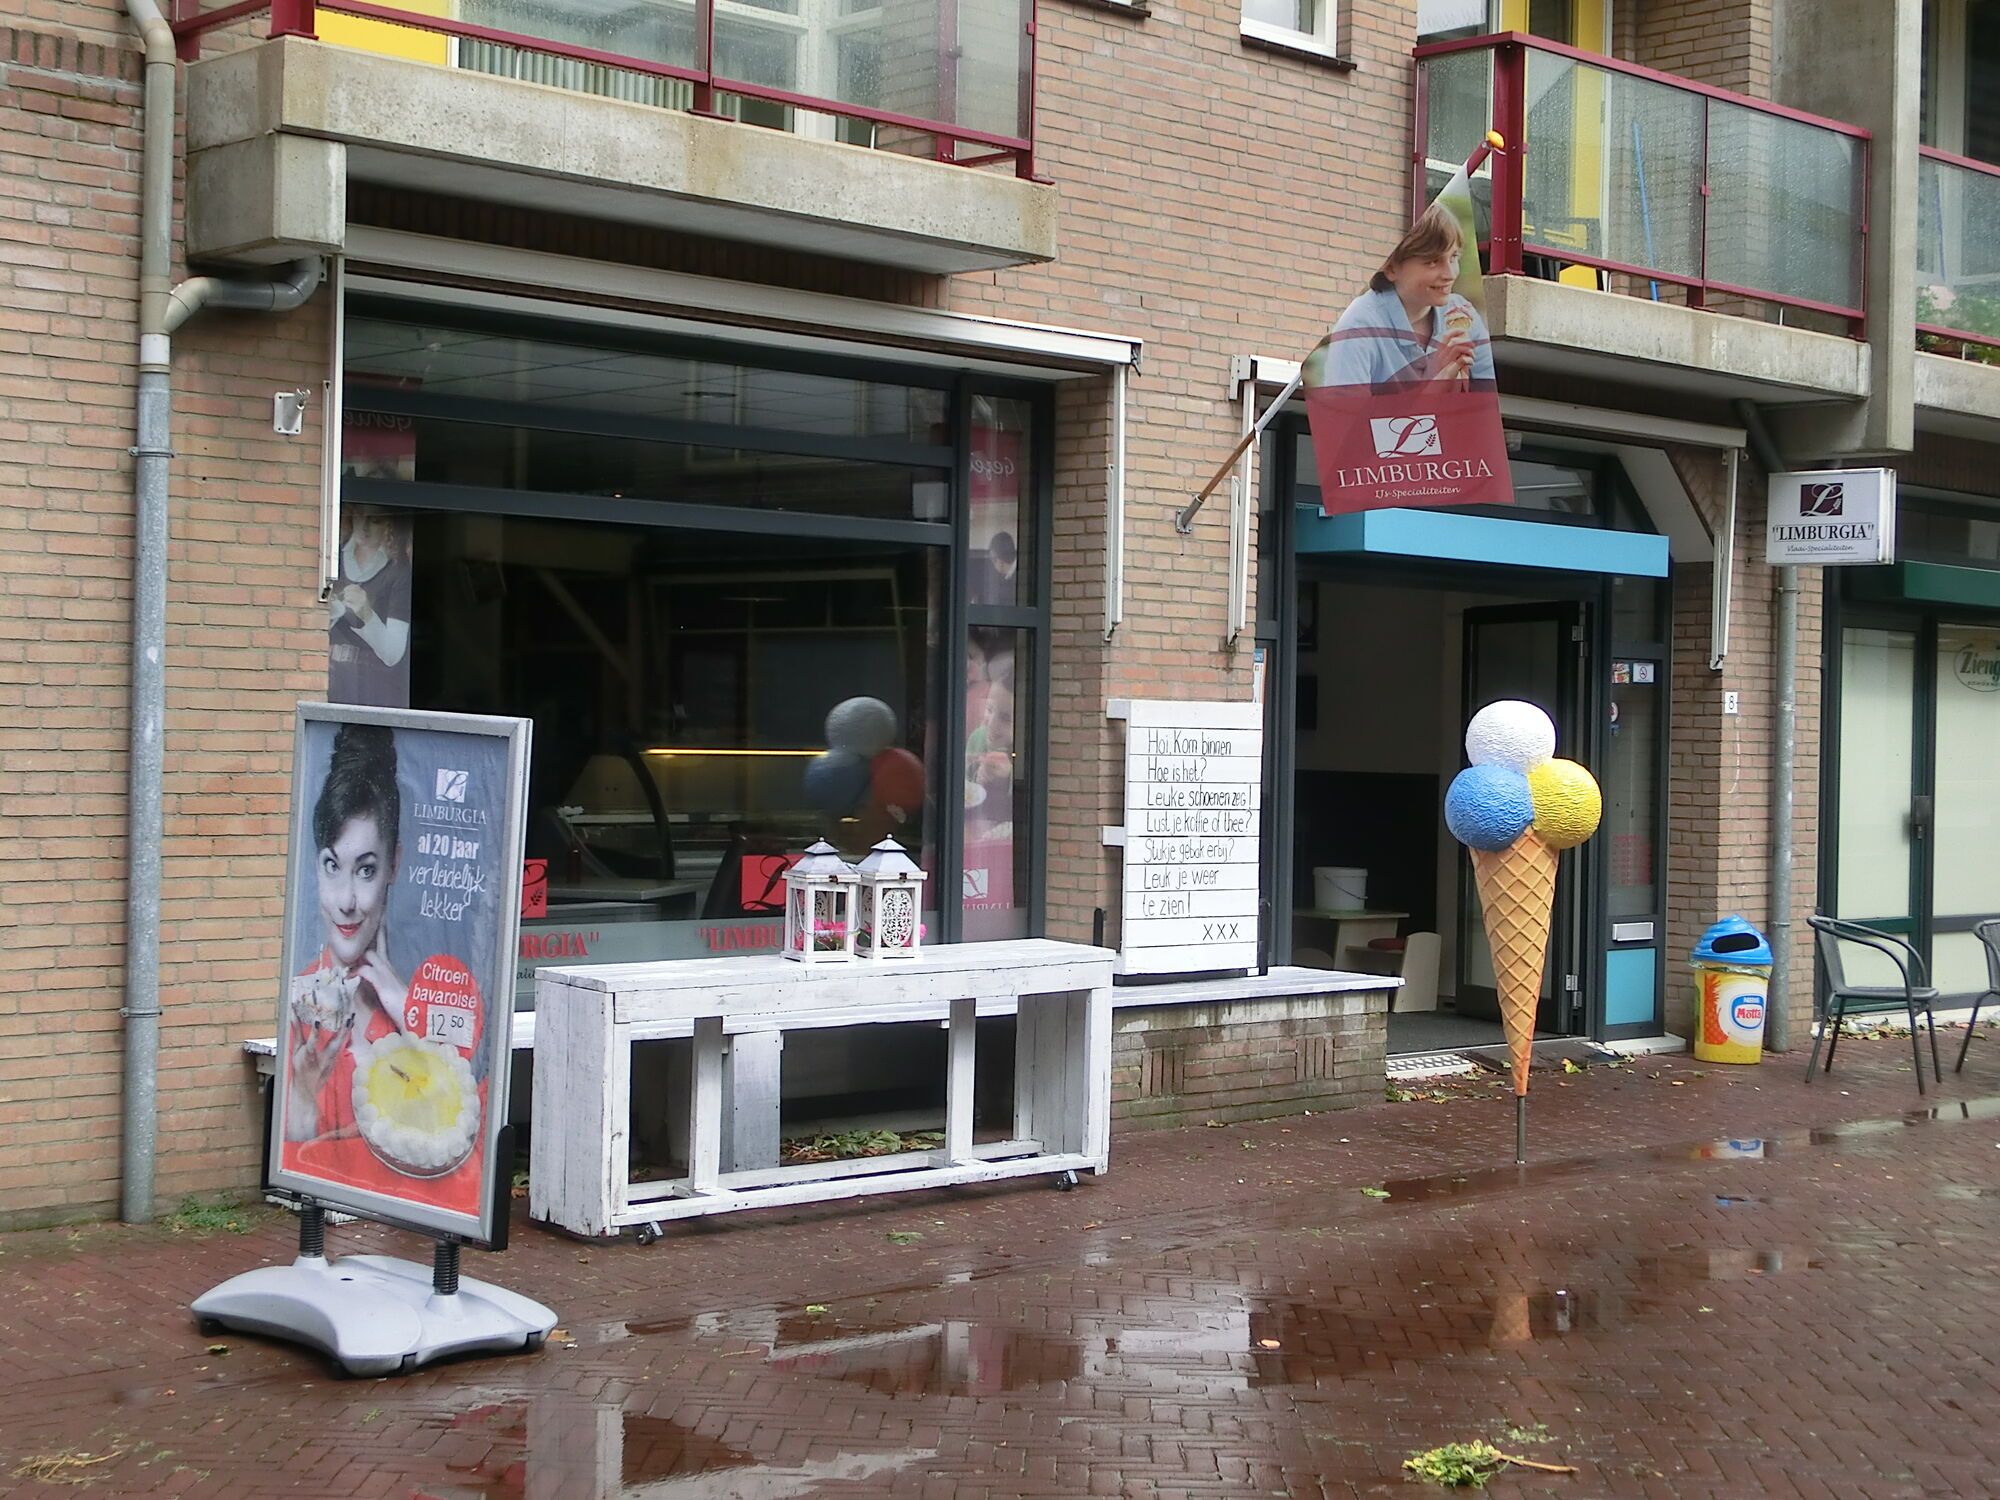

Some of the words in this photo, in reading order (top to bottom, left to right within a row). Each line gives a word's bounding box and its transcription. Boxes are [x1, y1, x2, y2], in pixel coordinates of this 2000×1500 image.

[1337, 459, 1494, 488] LIMBURGIA
[1772, 524, 1875, 541] "LIMBURGIA"
[1728, 695, 1735, 710] 8
[1174, 730, 1198, 753] Kom
[1202, 731, 1232, 756] binnen
[1148, 756, 1169, 782] Hoe
[1172, 764, 1181, 782] is
[1183, 757, 1207, 782] het?
[1147, 784, 1185, 807] Leuke
[1188, 784, 1230, 806] schoenen
[414, 803, 487, 825] LIMBURGIA
[1146, 811, 1171, 832] Lust
[1170, 814, 1182, 836] je
[1184, 811, 1209, 832] koffie
[1211, 811, 1222, 832] of
[1224, 809, 1253, 832] thee?
[418, 833, 431, 854] al
[432, 834, 449, 856] 20
[450, 836, 479, 859] jaar
[1144, 838, 1176, 864] Stukje
[1179, 839, 1205, 863] gebak
[1207, 838, 1235, 863] erbij?
[408, 860, 486, 906] verleidelijk
[1144, 866, 1170, 890] Leuk
[1176, 867, 1188, 890] je
[1191, 869, 1220, 885] weer
[420, 890, 465, 921] lekker
[1143, 894, 1156, 917] te
[1160, 891, 1191, 917] zien!
[518, 931, 600, 959] RGIA"
[422, 962, 468, 986] Citroen
[412, 983, 477, 1009] bavaroise
